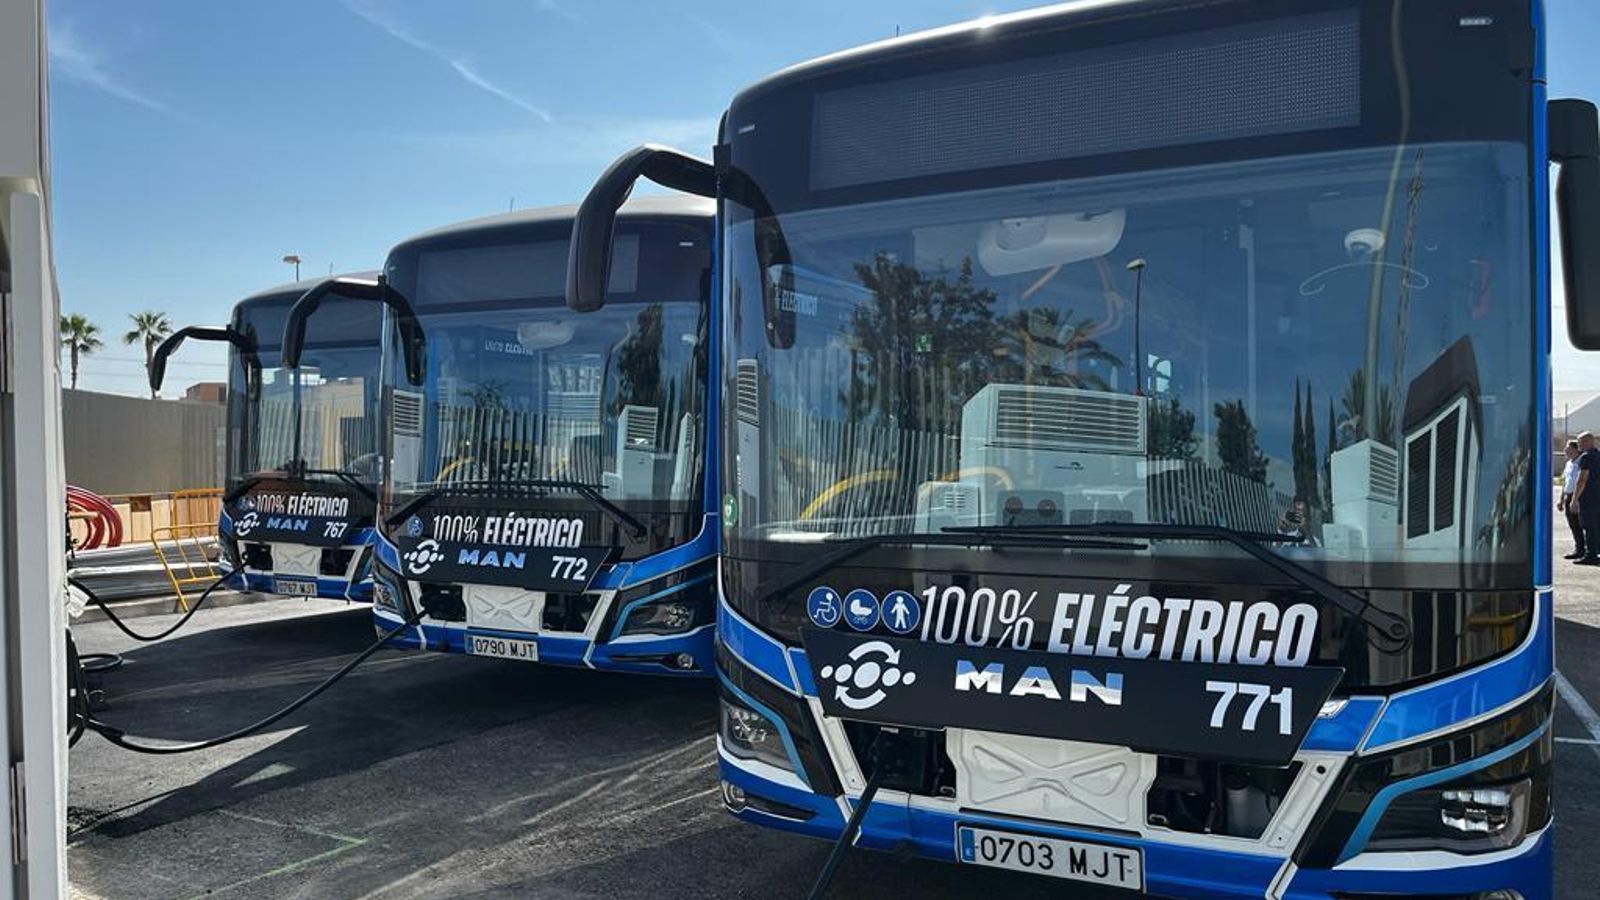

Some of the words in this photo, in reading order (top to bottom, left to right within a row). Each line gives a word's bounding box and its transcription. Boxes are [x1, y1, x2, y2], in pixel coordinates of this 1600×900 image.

[256, 494, 286, 514] 100%
[287, 492, 349, 518] ELÉCTRICO
[266, 517, 309, 531] MAN
[323, 521, 348, 538] 767
[433, 514, 480, 544] 100%
[483, 512, 584, 548] ELÉCTRICO
[457, 549, 526, 569] MAN
[550, 555, 588, 581] 772
[920, 585, 1038, 651] 100%
[1048, 584, 1319, 666] ELÉCTRICO
[475, 637, 505, 656] 0790
[509, 640, 535, 659] MJT
[955, 660, 1124, 705] MAN
[1205, 681, 1293, 735] 771
[980, 835, 1054, 870] 0703
[1069, 846, 1130, 882] MJT
